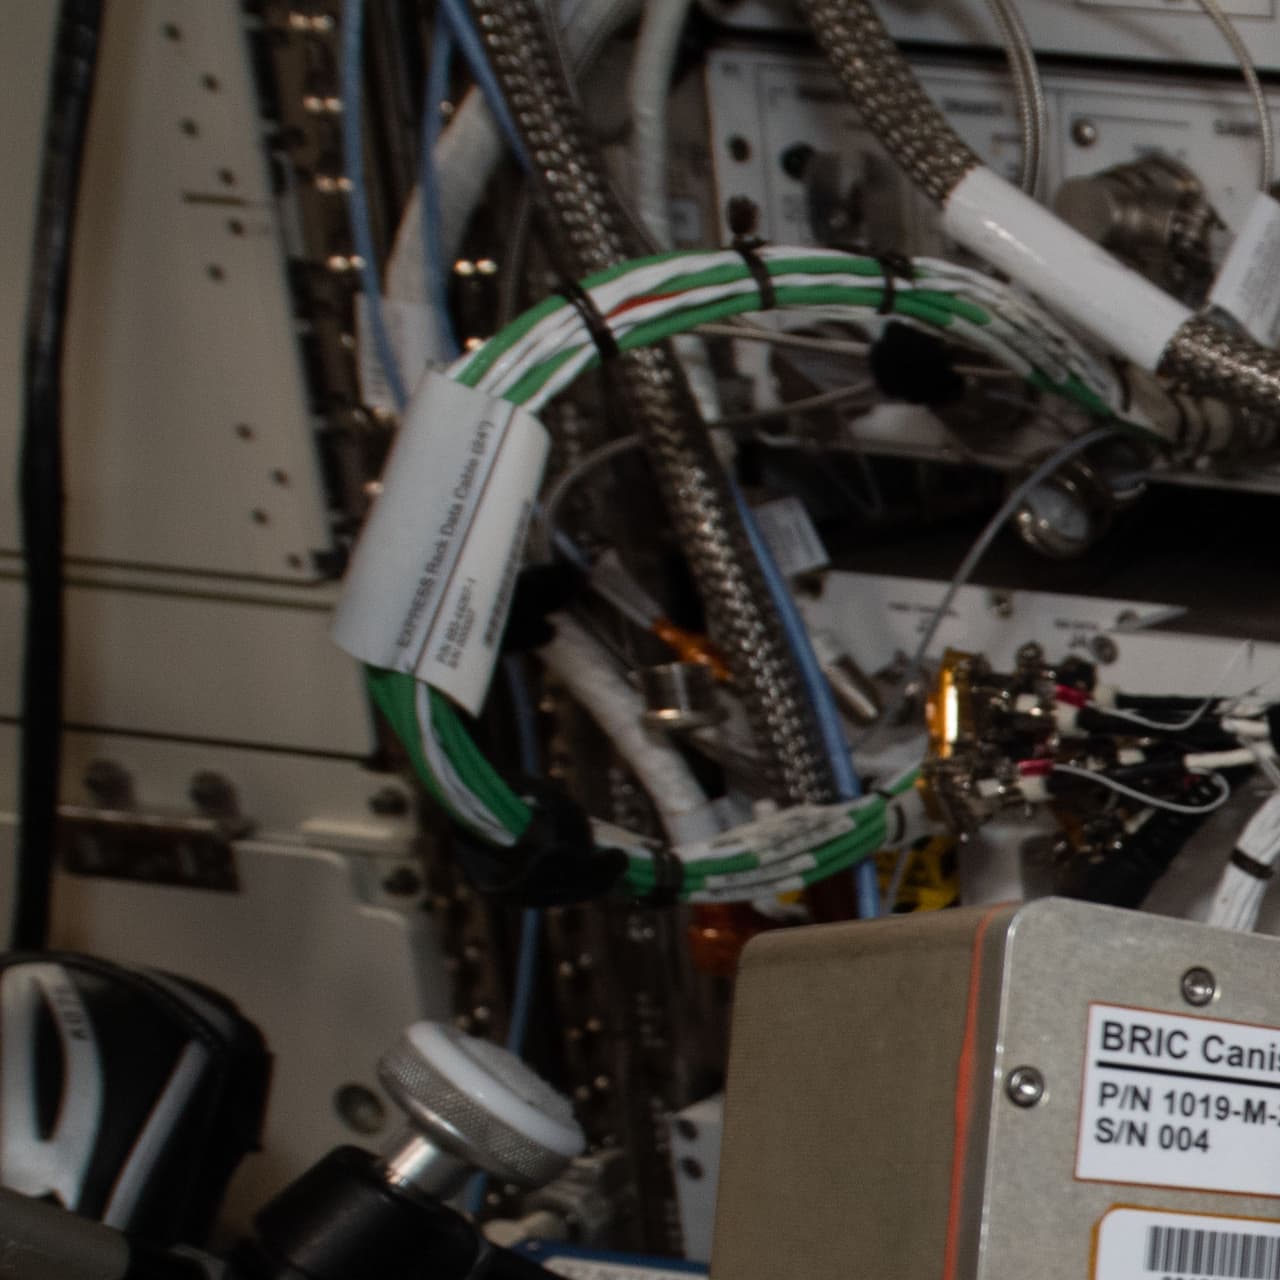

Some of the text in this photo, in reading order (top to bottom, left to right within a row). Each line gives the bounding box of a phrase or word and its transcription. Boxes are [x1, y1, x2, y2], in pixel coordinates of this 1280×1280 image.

[397, 577, 435, 649] EXPRESS
[425, 537, 449, 575] Rack
[440, 503, 464, 538] Data
[454, 457, 481, 499] Cable
[1102, 1021, 1188, 1059] BRIC
[1100, 1082, 1151, 1112] P/N
[1095, 1117, 1210, 1151] S/N 004
